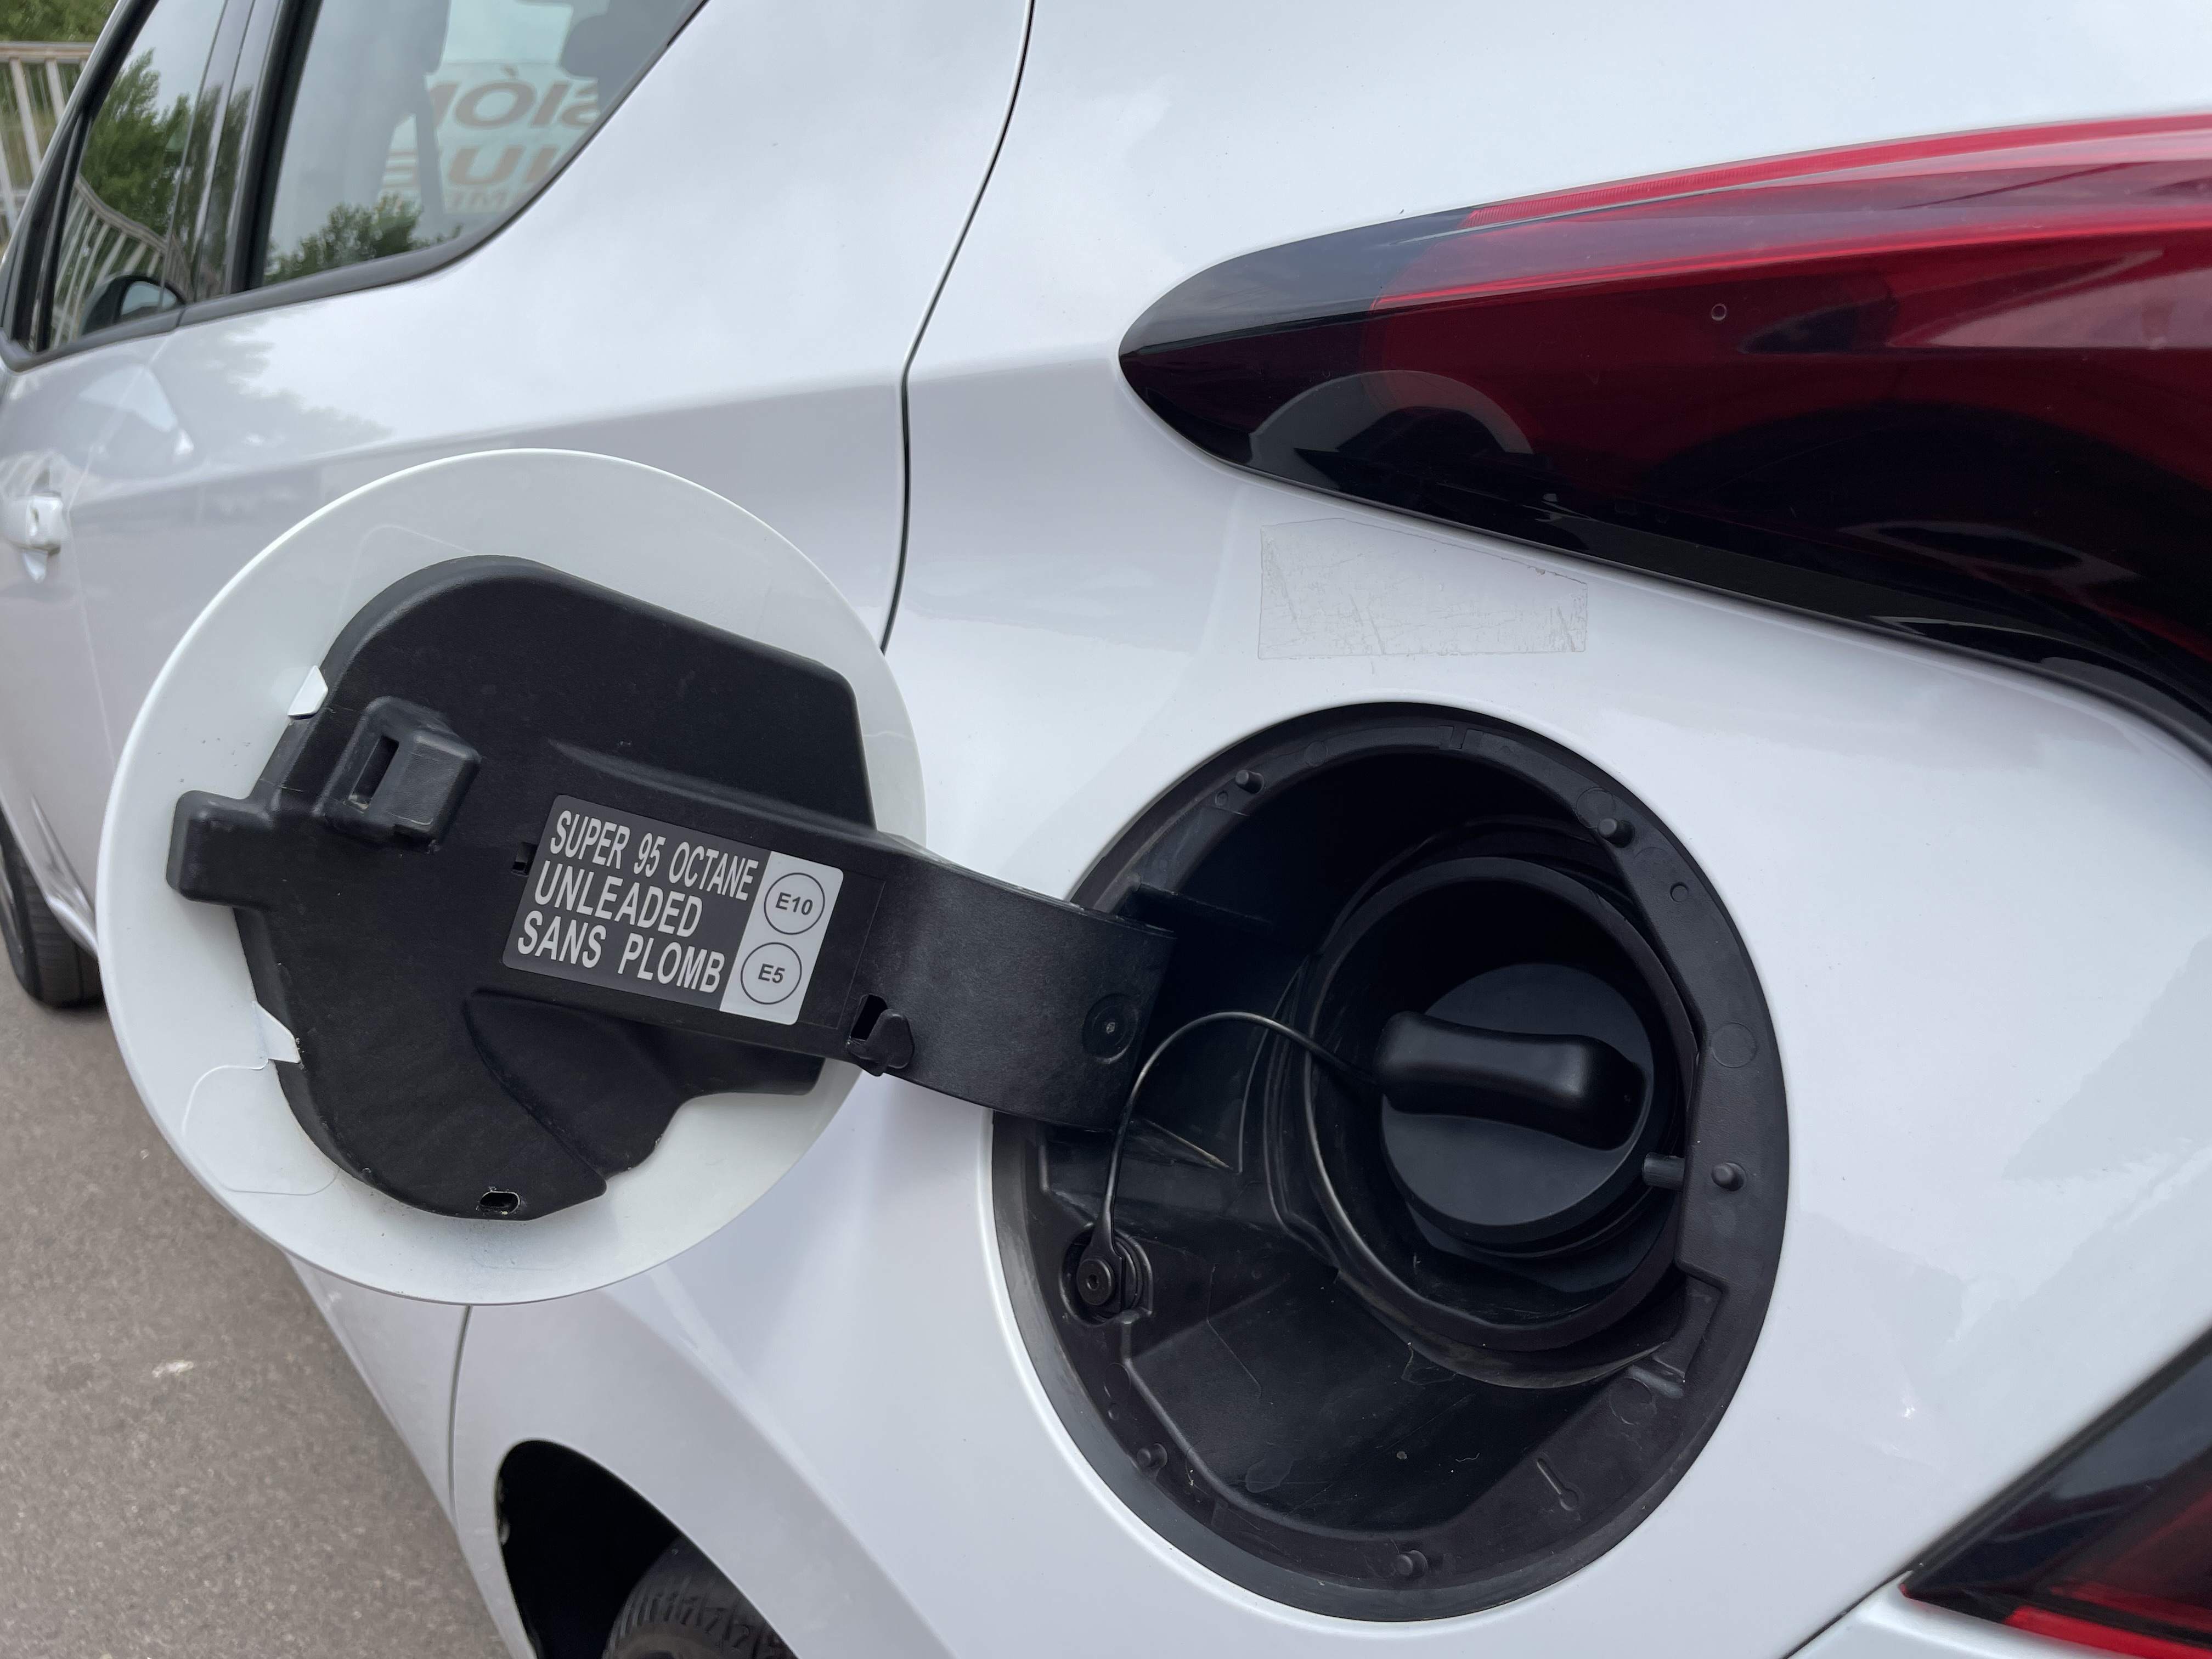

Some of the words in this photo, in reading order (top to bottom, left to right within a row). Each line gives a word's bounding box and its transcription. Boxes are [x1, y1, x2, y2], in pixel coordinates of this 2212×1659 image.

[550, 810, 630, 870] SUPER
[633, 832, 666, 877] 95
[669, 842, 759, 901] OCTANE
[534, 860, 703, 938] UNLEADED
[775, 891, 813, 915] E10
[517, 910, 606, 968] SANS
[617, 933, 725, 993] PLOMB
[758, 963, 785, 984] E5
